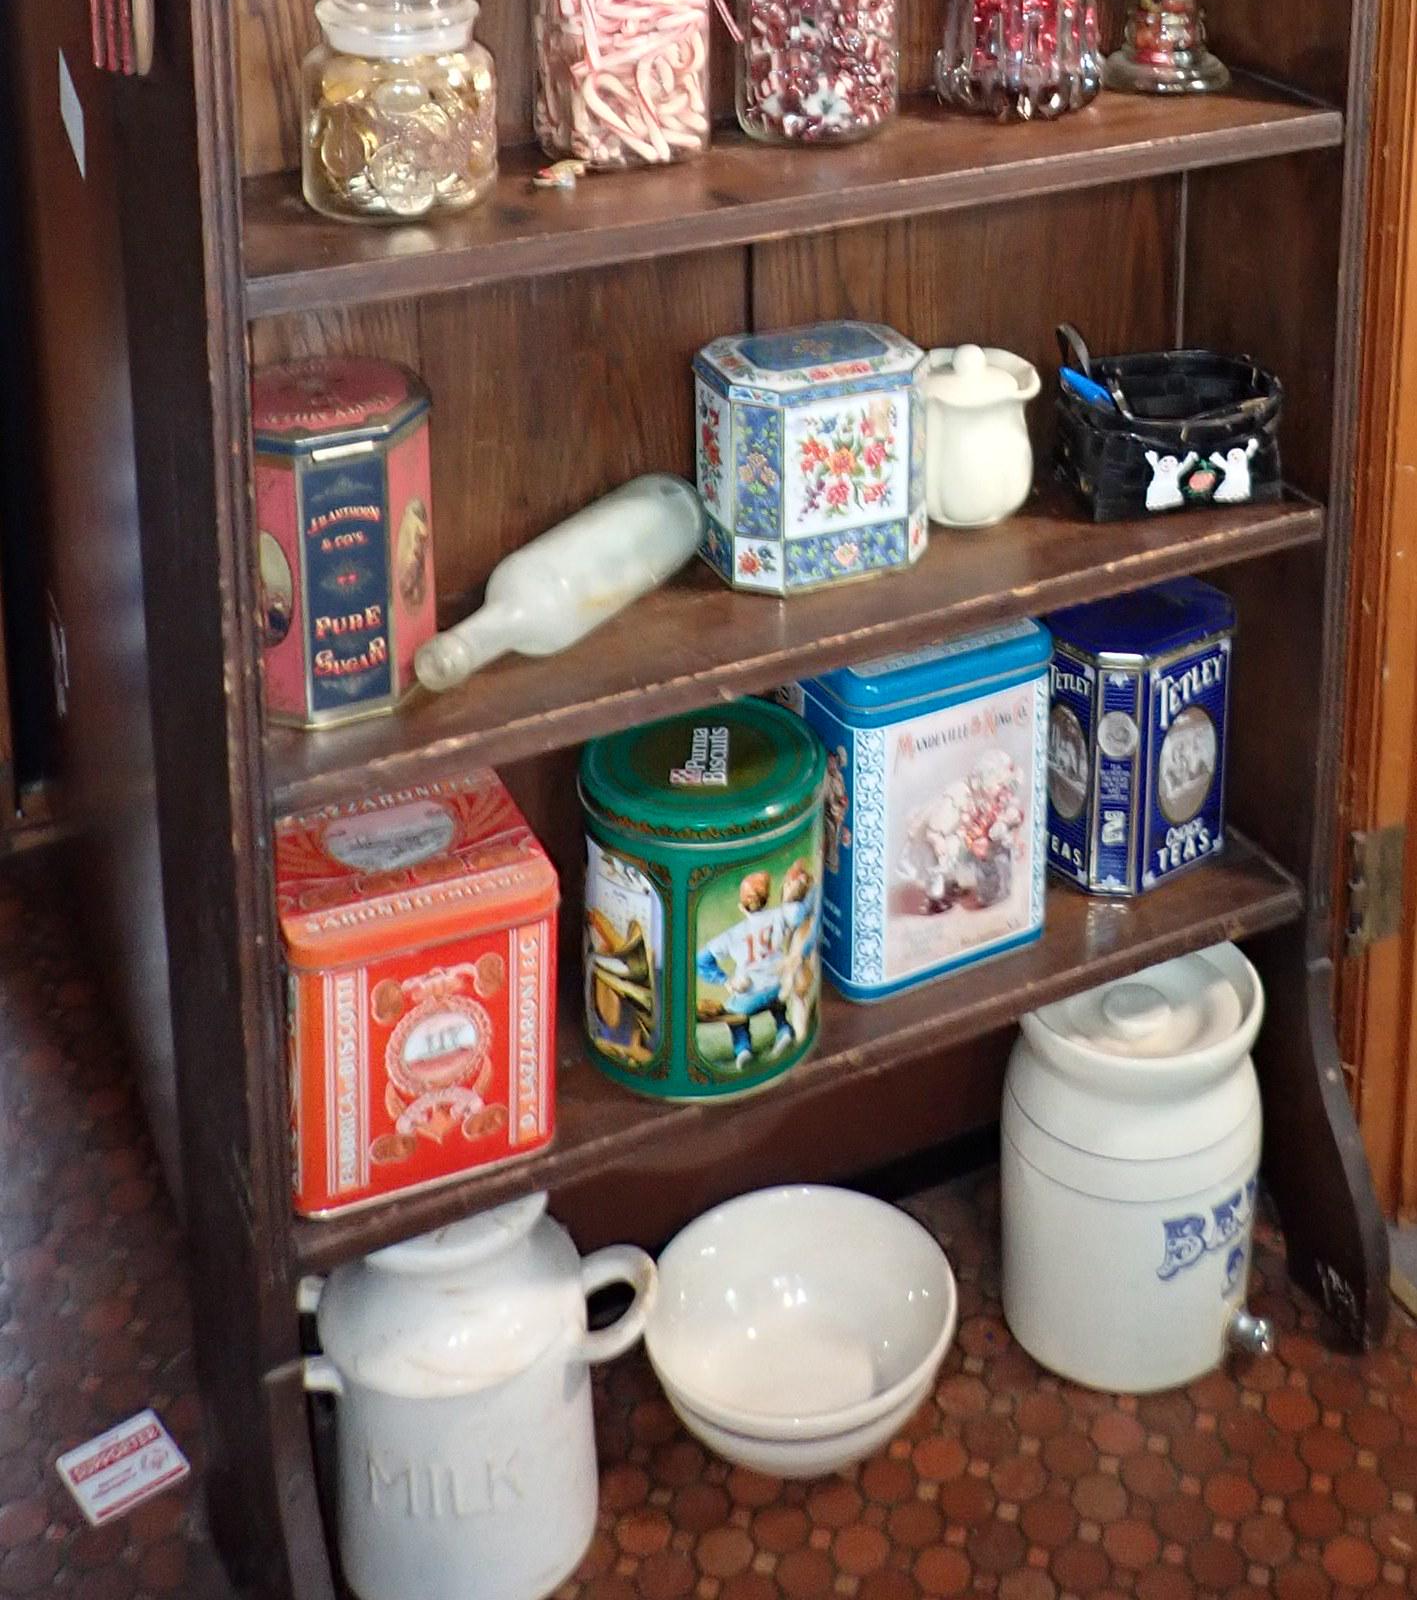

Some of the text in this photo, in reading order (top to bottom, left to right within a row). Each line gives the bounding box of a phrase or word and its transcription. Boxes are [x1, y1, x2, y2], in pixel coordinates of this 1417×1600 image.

[315, 604, 382, 640] PURE
[314, 636, 387, 678] SUGAR
[1050, 663, 1092, 699] TETLEY
[1156, 653, 1225, 731] TETLEY
[1045, 831, 1083, 868] EAS
[1156, 827, 1210, 873] TEAS
[367, 1446, 526, 1520] MILK
